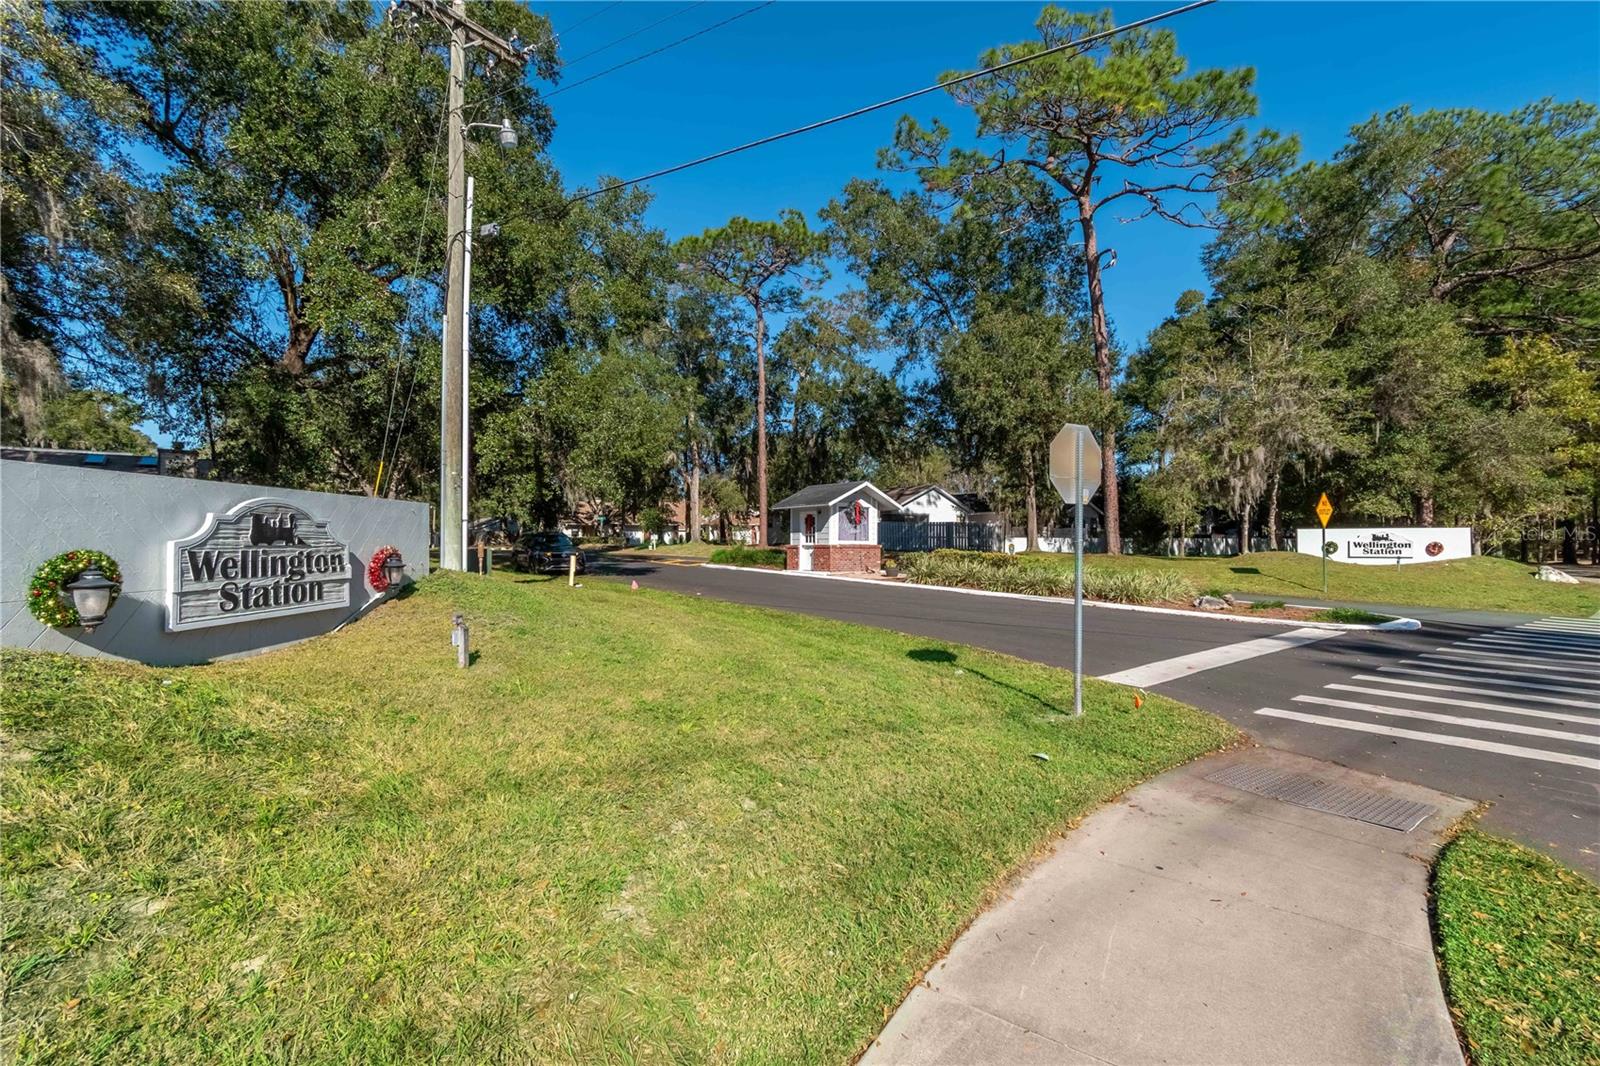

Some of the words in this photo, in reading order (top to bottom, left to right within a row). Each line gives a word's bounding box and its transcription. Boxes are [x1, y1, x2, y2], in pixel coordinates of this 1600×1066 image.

[1353, 541, 1411, 549] Wellington
[186, 549, 345, 582] Wellington
[219, 581, 324, 612] Station
